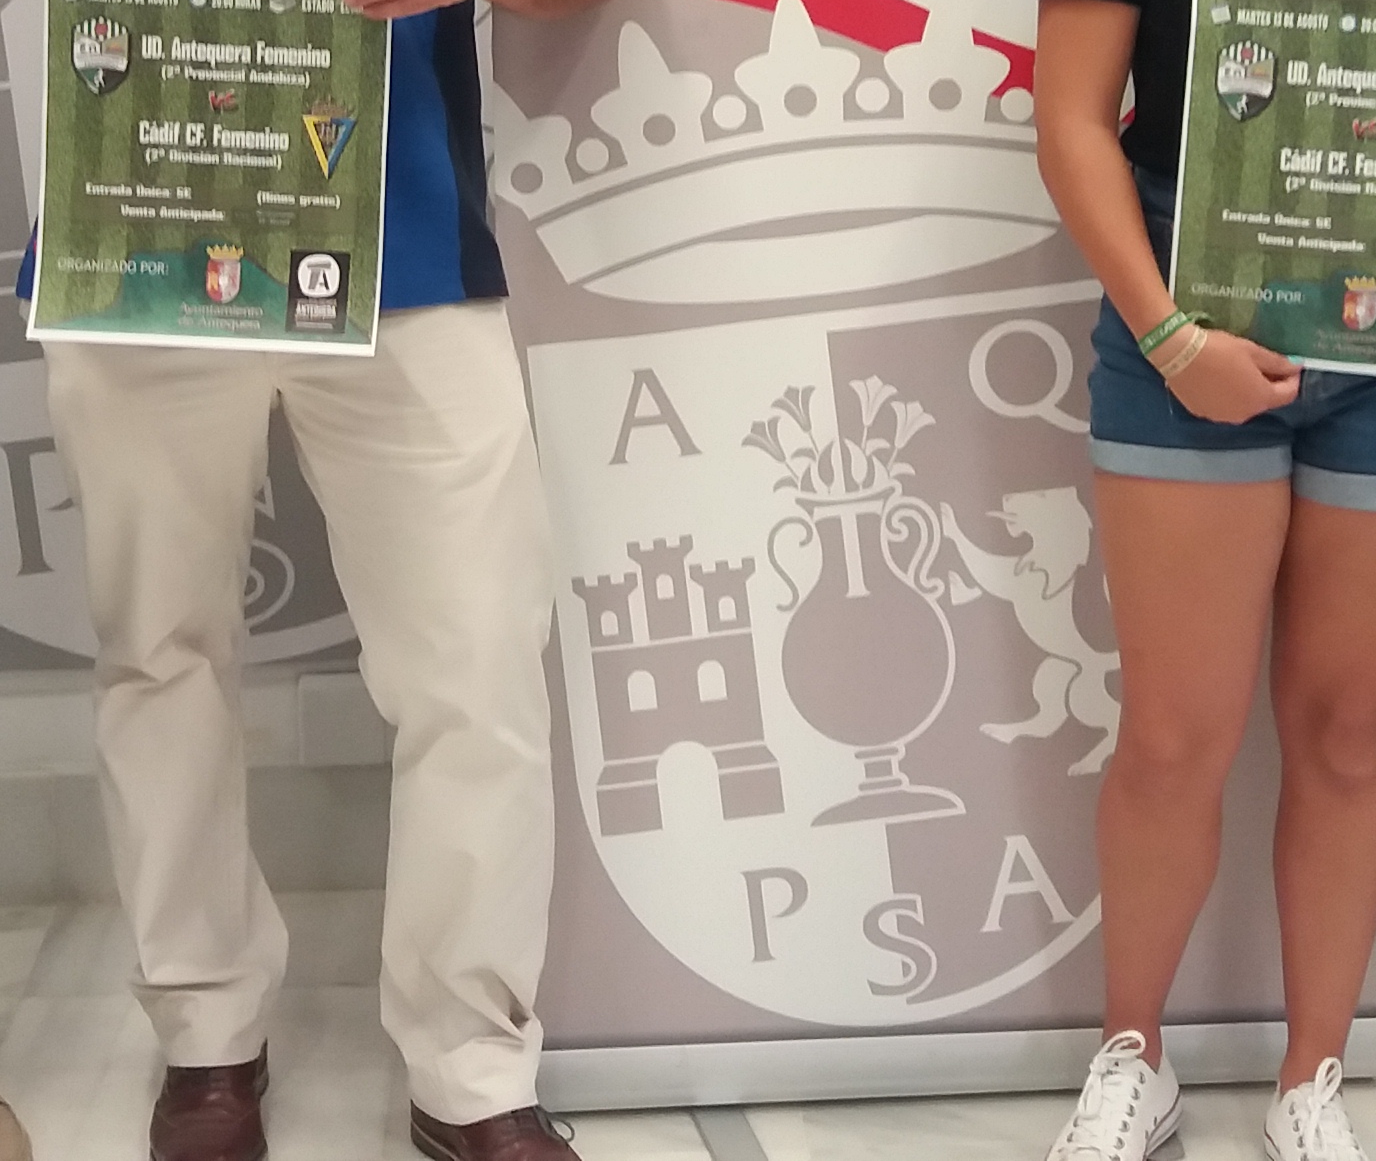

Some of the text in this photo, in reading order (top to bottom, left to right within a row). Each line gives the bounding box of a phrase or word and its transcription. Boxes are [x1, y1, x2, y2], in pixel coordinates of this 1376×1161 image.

[141, 34, 331, 68] UD. Antequera Femenino
[1286, 60, 1312, 86] UD.
[185, 122, 207, 147] CF.
[212, 123, 290, 152] Femenino
[1327, 150, 1350, 176] CF.
